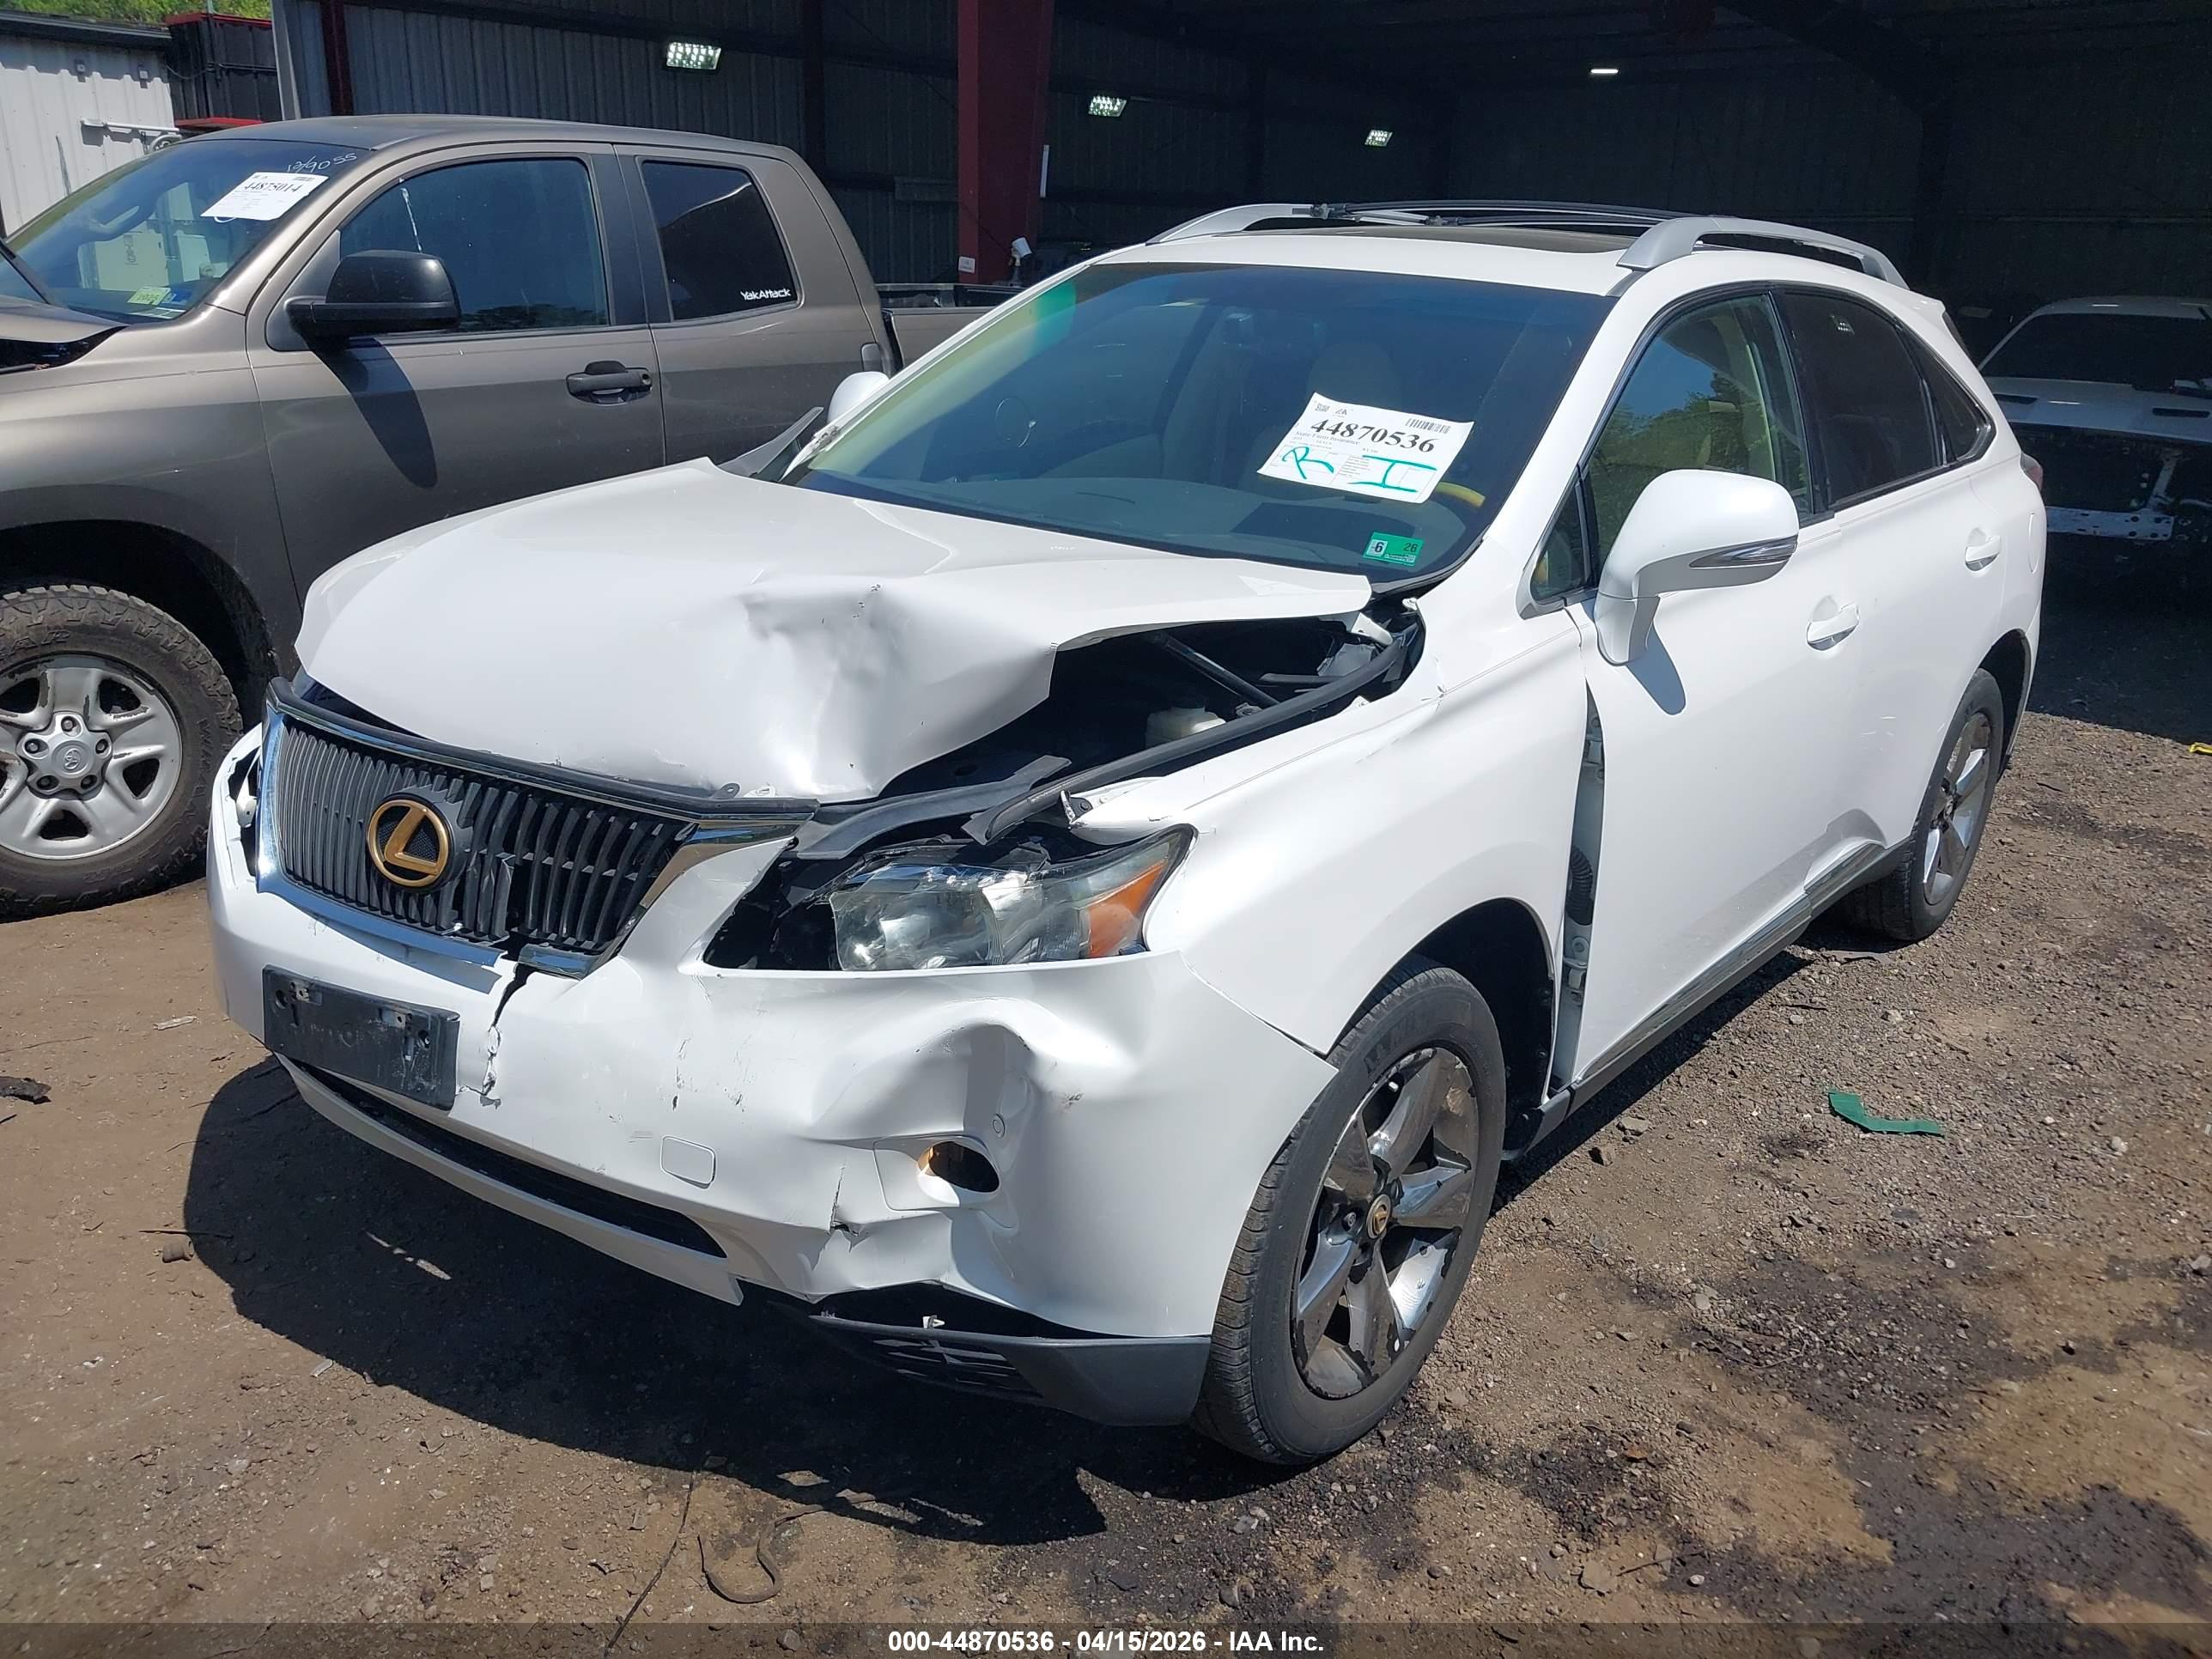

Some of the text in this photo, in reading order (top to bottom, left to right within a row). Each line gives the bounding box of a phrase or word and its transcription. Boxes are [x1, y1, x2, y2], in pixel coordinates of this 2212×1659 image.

[244, 182, 304, 193] 44875014
[740, 288, 792, 301] YakAttack
[1310, 418, 1439, 453] 44870536
[1403, 542, 1419, 553] 26
